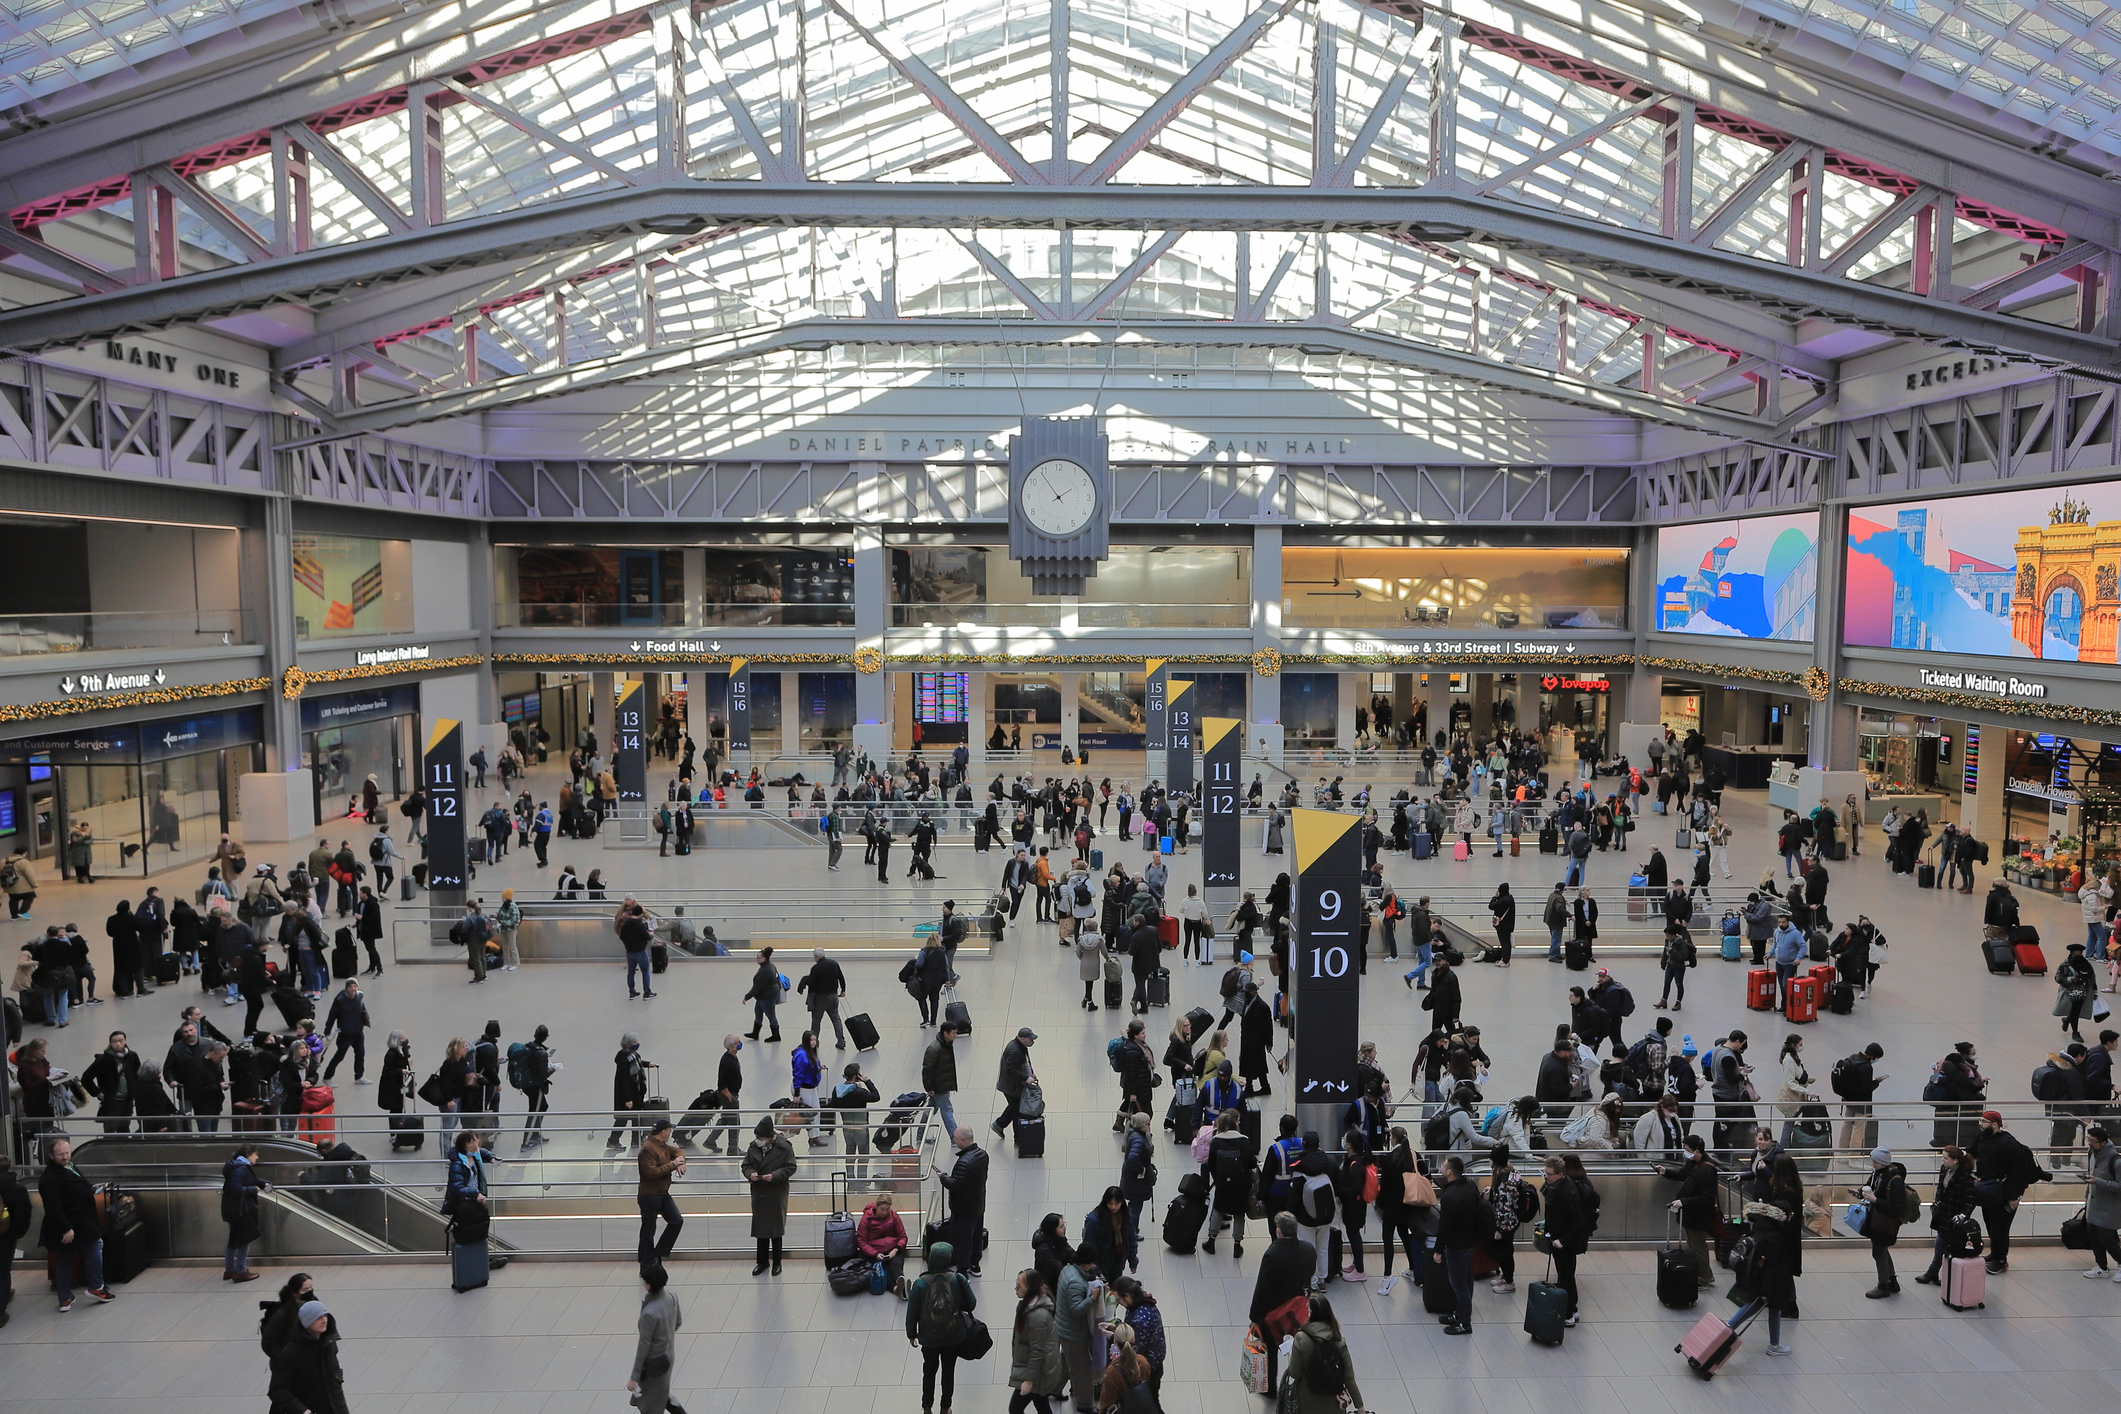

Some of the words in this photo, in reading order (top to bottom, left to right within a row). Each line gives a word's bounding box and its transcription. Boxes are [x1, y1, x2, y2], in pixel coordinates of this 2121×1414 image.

[106, 341, 177, 373] MANY
[197, 364, 240, 388] ONE
[1906, 357, 2008, 390] EXCELS
[789, 438, 882, 451] DANIEL
[901, 438, 1010, 452] PATRIC
[1190, 440, 1267, 453] TRAIN
[1287, 440, 1347, 454] HALL
[646, 641, 676, 652] Food
[679, 641, 704, 652] Hall
[1354, 642, 1373, 653] 8th
[1377, 642, 1419, 653] Avenue
[1423, 642, 1432, 653] &
[1435, 642, 1461, 653] 33rd
[1464, 642, 1501, 653] Street
[1514, 642, 1559, 655] Subway
[357, 651, 376, 666] Long
[376, 647, 398, 661] Island
[399, 646, 411, 660] Rail
[412, 645, 429, 659] Road
[80, 673, 103, 693] 9th
[105, 672, 150, 691] Avenue
[733, 682, 746, 693] 15
[1150, 682, 1162, 694] 15
[1561, 677, 1610, 691] lovepop
[1920, 669, 1963, 689] Ticketed
[1965, 673, 2007, 697] Waiting
[2009, 677, 2044, 698] Room
[734, 700, 747, 711] 16
[1150, 700, 1163, 711] 16
[622, 711, 639, 726] 13
[1173, 711, 1189, 725] 13
[4, 740, 22, 749] and
[25, 740, 70, 749] Customer
[74, 739, 110, 750] Service
[622, 735, 640, 750] 14
[1172, 735, 1189, 749] 14
[433, 763, 453, 783] 11
[1213, 762, 1232, 781] 11
[2009, 776, 2045, 795] Damselfly
[2047, 784, 2077, 800] Flowers
[433, 797, 457, 817] 12
[1211, 795, 1234, 814] 12
[1319, 889, 1342, 921] 9
[1310, 946, 1349, 978] 10
